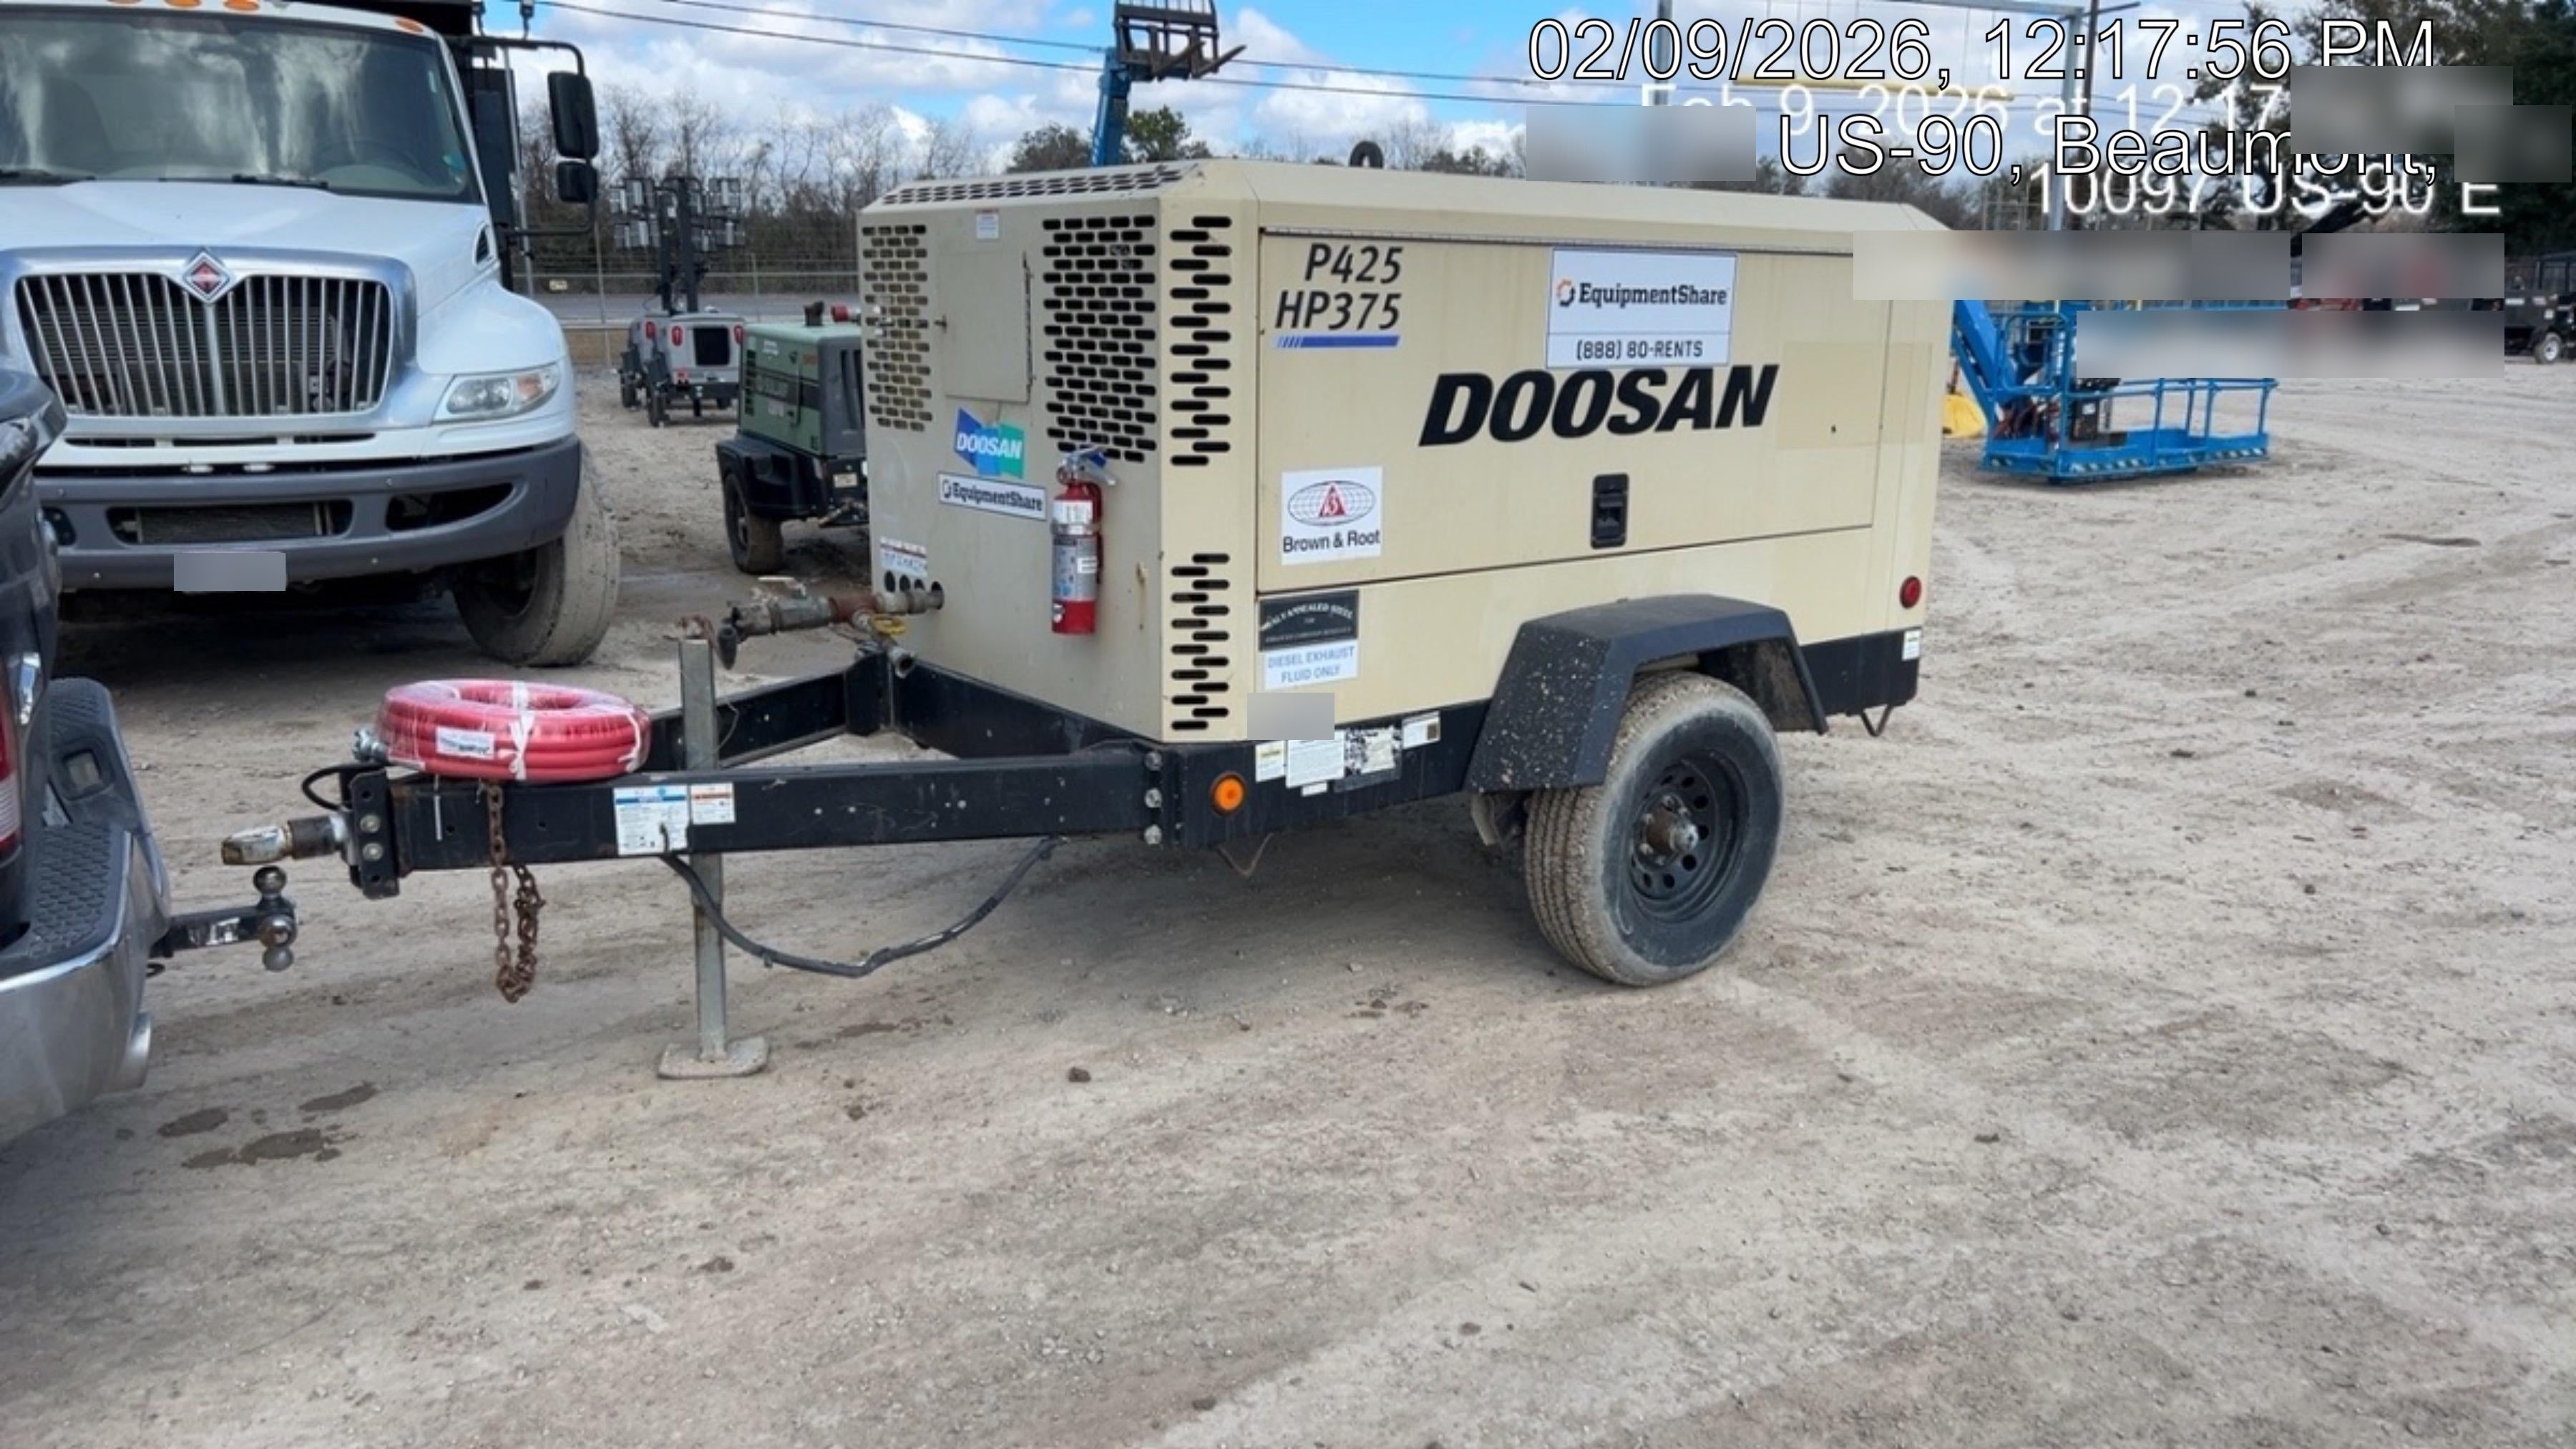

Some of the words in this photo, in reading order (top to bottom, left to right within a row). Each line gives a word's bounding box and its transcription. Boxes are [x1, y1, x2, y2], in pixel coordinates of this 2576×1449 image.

[1304, 242, 1403, 284] P425
[1579, 282, 1727, 308] EquipmentShare
[1274, 289, 1402, 330] HP375
[1576, 339, 1621, 361] (888)
[1626, 340, 1704, 359] 80-RENTS
[1418, 364, 1780, 447] DOOSAN
[956, 432, 1023, 459] DOOSAN
[952, 482, 1043, 511] EquipmentShare
[1283, 535, 1329, 552] Brown
[1333, 532, 1343, 548] &
[1347, 529, 1380, 547] Root
